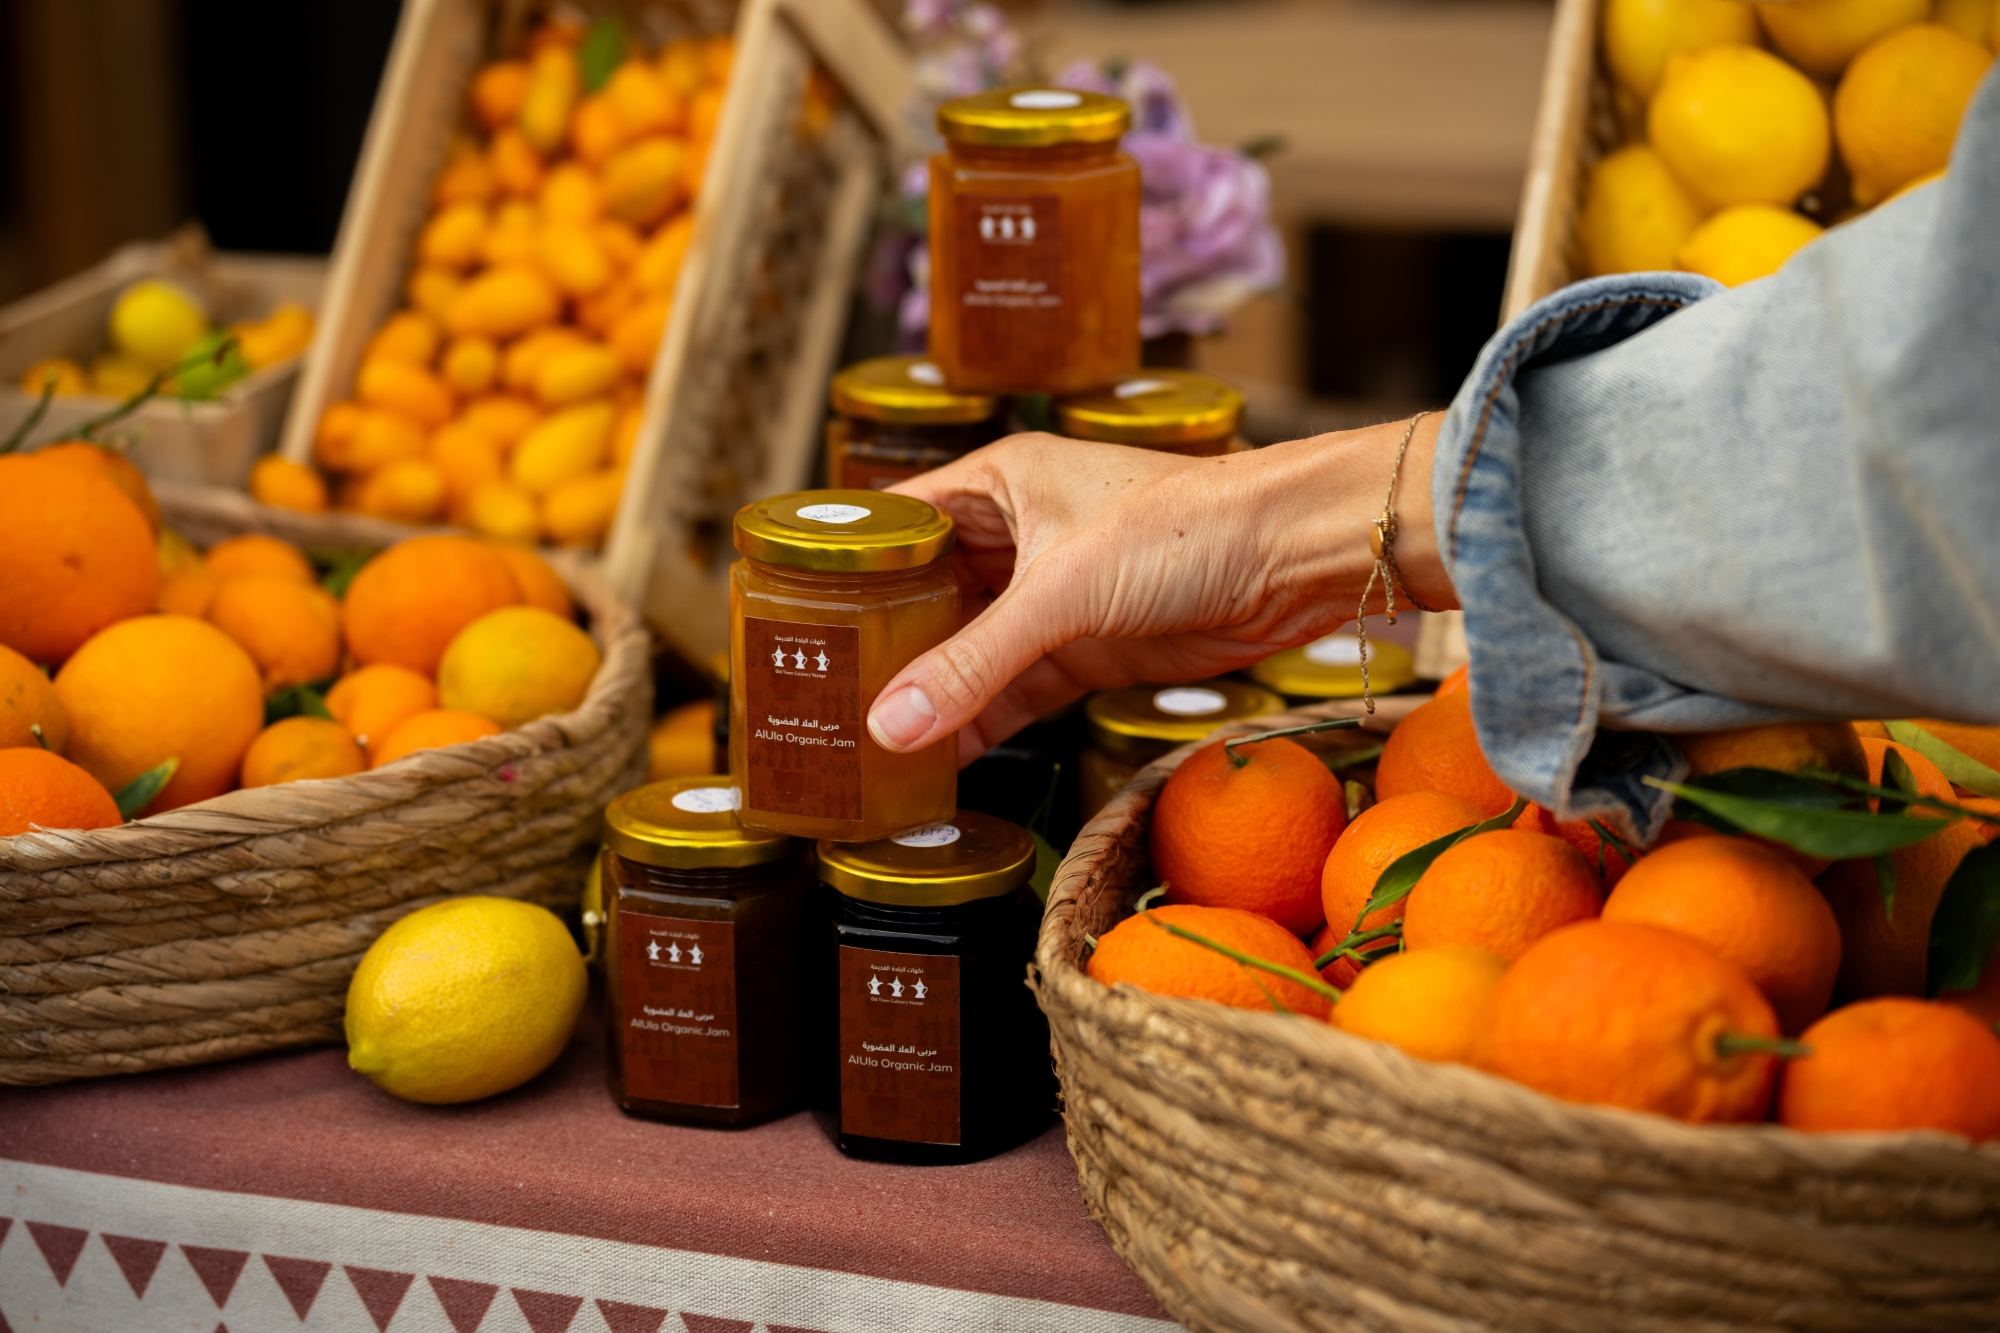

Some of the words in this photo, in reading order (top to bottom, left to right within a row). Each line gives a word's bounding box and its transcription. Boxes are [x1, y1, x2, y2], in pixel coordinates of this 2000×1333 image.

[768, 715, 799, 726] العضوية
[801, 719, 818, 728] العلا
[820, 723, 839, 731] مربى
[755, 729, 783, 741] AlUla
[786, 733, 828, 745] Organic
[830, 738, 855, 747] Jam
[631, 1018, 659, 1030] AlUla
[661, 1022, 702, 1035] Organic
[705, 1027, 729, 1037] Jam
[862, 1042, 895, 1052] العضوية
[897, 1045, 915, 1053] العلا
[848, 1055, 877, 1067] AlUla
[881, 1059, 925, 1071] Organic
[927, 1063, 952, 1072] Jam
